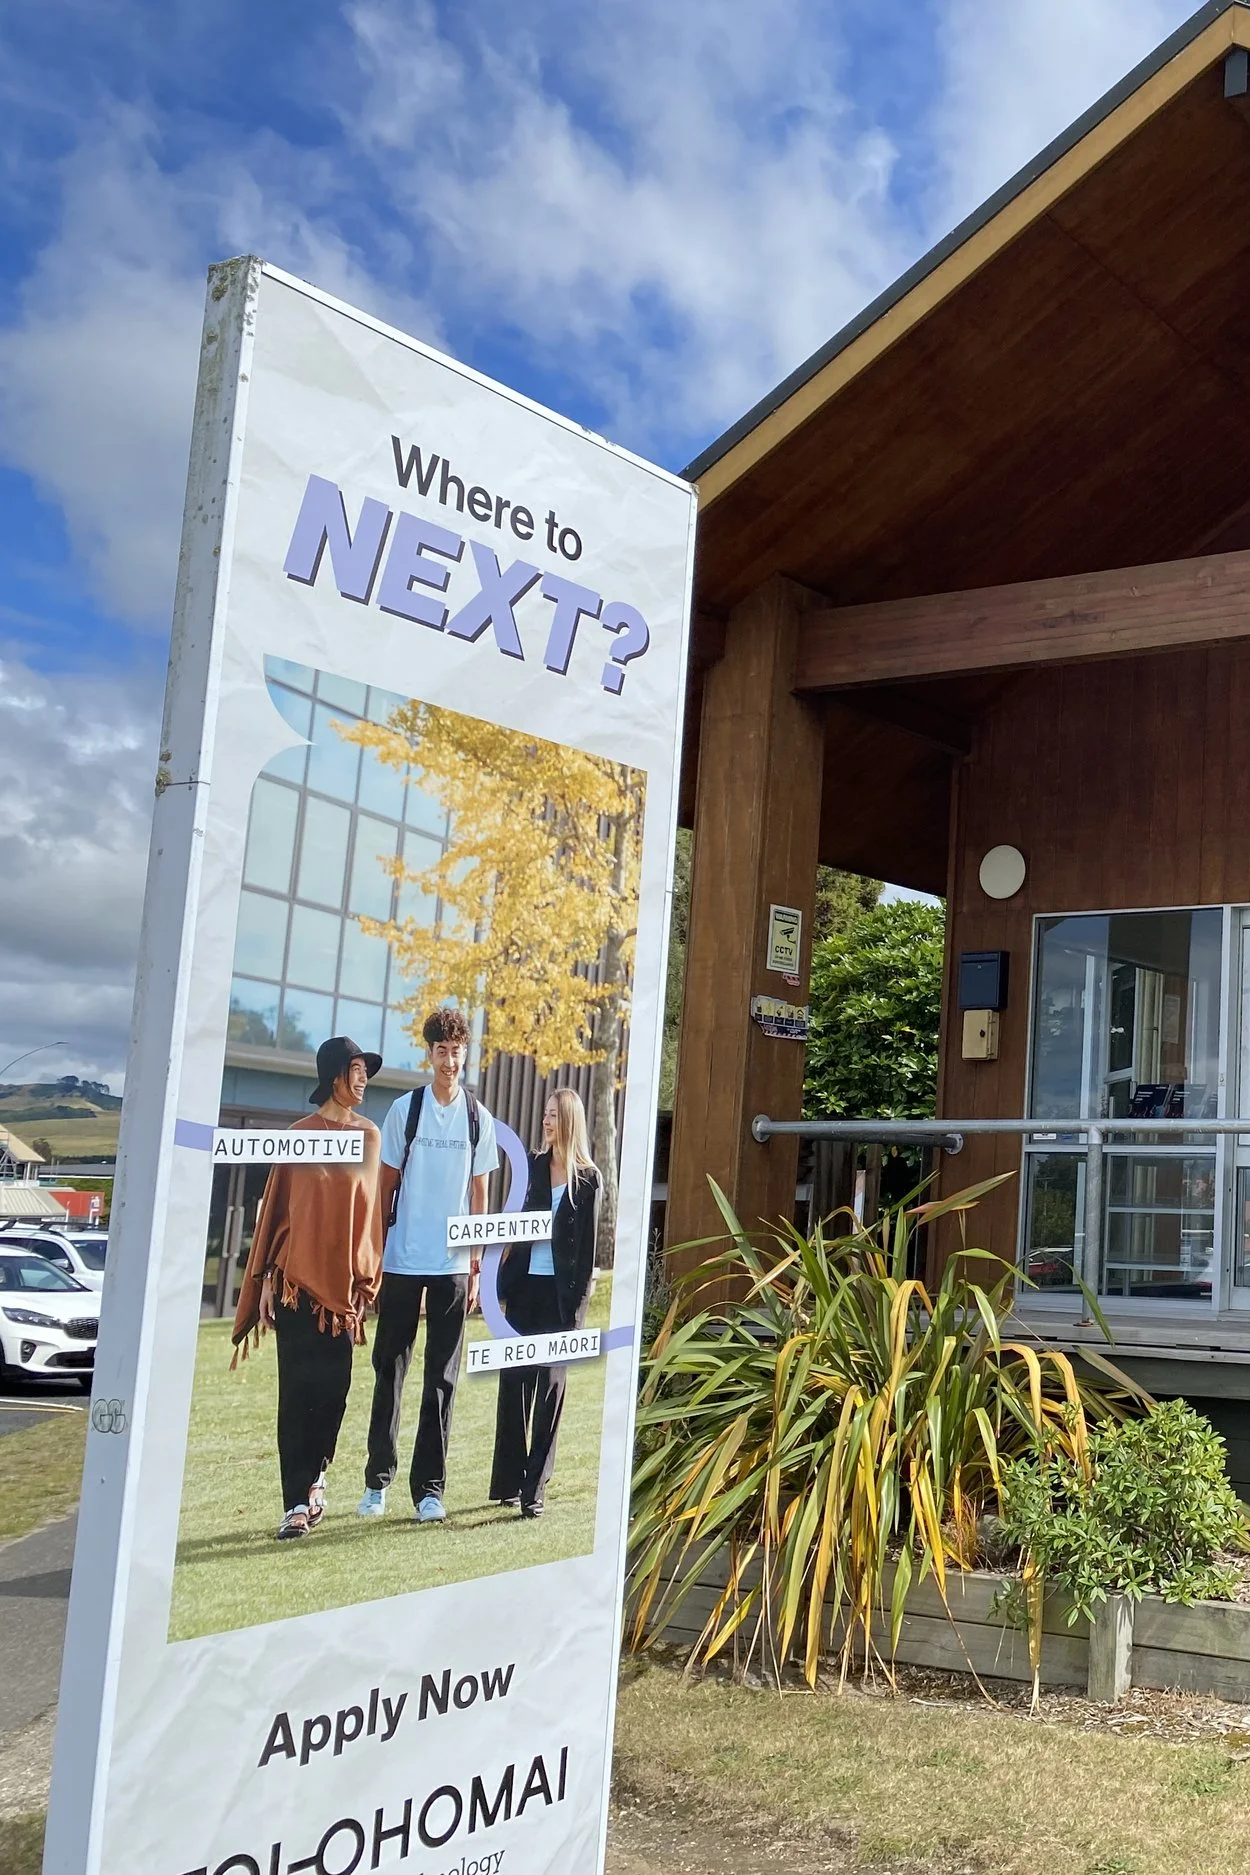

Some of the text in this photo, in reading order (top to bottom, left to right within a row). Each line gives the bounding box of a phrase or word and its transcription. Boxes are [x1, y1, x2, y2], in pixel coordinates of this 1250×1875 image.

[391, 434, 583, 561] Where to
[283, 473, 650, 696] NEXT?
[774, 945, 794, 956] CCTV
[214, 1138, 362, 1156] AUTOMOTIVE
[449, 1218, 551, 1240] CARPENTRY
[469, 1335, 598, 1366] TE REO MĀORI
[258, 1663, 516, 1767] Apply Now
